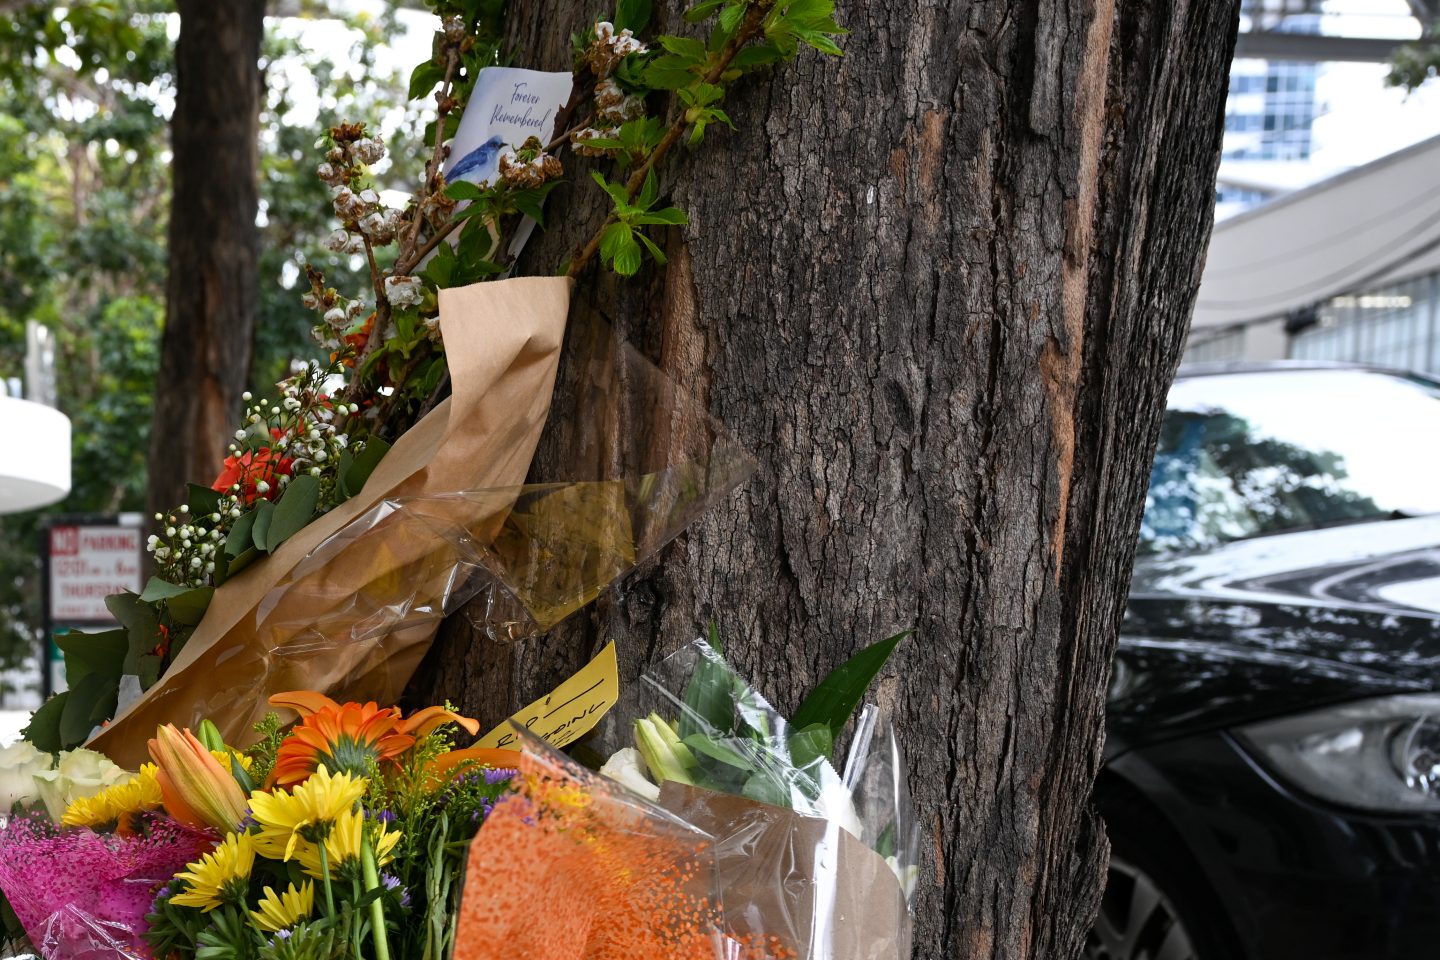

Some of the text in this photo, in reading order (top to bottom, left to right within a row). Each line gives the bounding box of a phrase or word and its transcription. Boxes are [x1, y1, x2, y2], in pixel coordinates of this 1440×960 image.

[510, 82, 540, 105] Forever
[489, 103, 552, 132] Remembered
[83, 535, 136, 551] PARKING
